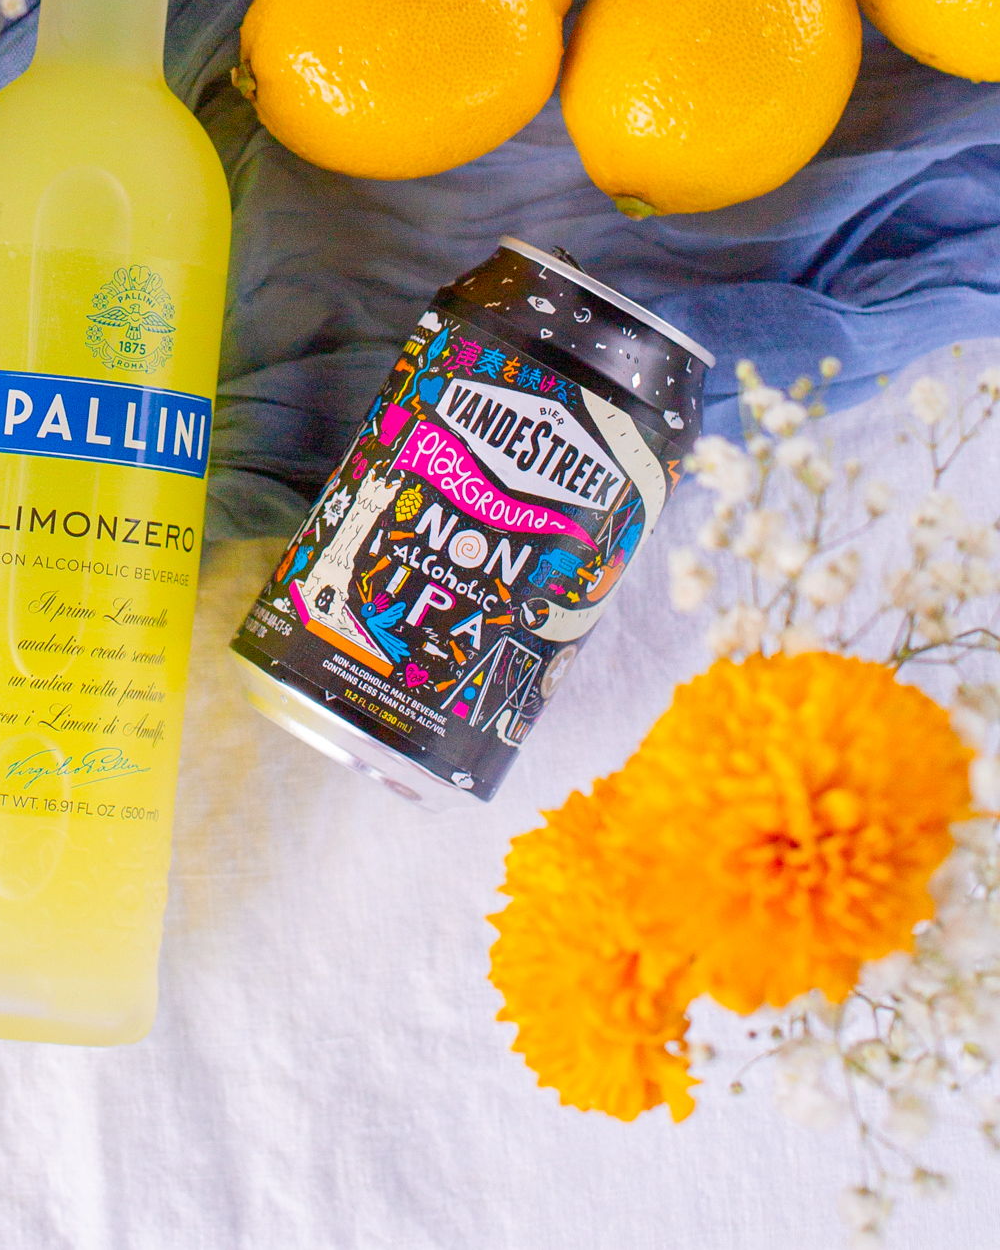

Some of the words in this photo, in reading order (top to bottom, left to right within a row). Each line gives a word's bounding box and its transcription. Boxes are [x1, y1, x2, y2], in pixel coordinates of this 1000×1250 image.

[117, 292, 156, 308] PALLINI
[119, 341, 147, 355] 1875
[116, 360, 144, 369] ROMA
[3, 388, 206, 461] PALLINI
[539, 406, 564, 426] BIER
[445, 385, 619, 507] VANDESTREEK
[415, 502, 532, 586] NON
[32, 555, 129, 578] ALCOHOLIC
[134, 567, 189, 587] BEVERAGE
[49, 602, 97, 623] primo
[103, 597, 168, 629] Limoncello
[17, 633, 85, 655] analcolico
[90, 644, 127, 660] creato
[131, 646, 166, 665] secondo
[8, 673, 74, 693] un'antica
[79, 678, 118, 697] ricetta
[322, 659, 359, 685] CONTAINS
[358, 680, 378, 697] LESS
[378, 691, 399, 710] THAN
[398, 704, 417, 720] 0.5%
[416, 715, 448, 738] ALC/VOL
[332, 653, 391, 693] NON-ALCOHOLIC
[390, 687, 412, 706] MALT
[411, 697, 448, 726] BEVERAGE
[24, 710, 35, 725] i
[37, 702, 101, 733] Limoni
[102, 715, 120, 735] di
[344, 688, 358, 702] 11.2
[357, 696, 368, 708] FL
[367, 703, 380, 714] OZ
[379, 709, 398, 725] (330
[397, 719, 415, 734] mL)
[12, 795, 39, 810] WT.
[43, 798, 74, 814] 16.91
[77, 802, 93, 816] FL
[96, 803, 116, 818] OZ
[120, 805, 145, 820] (500
